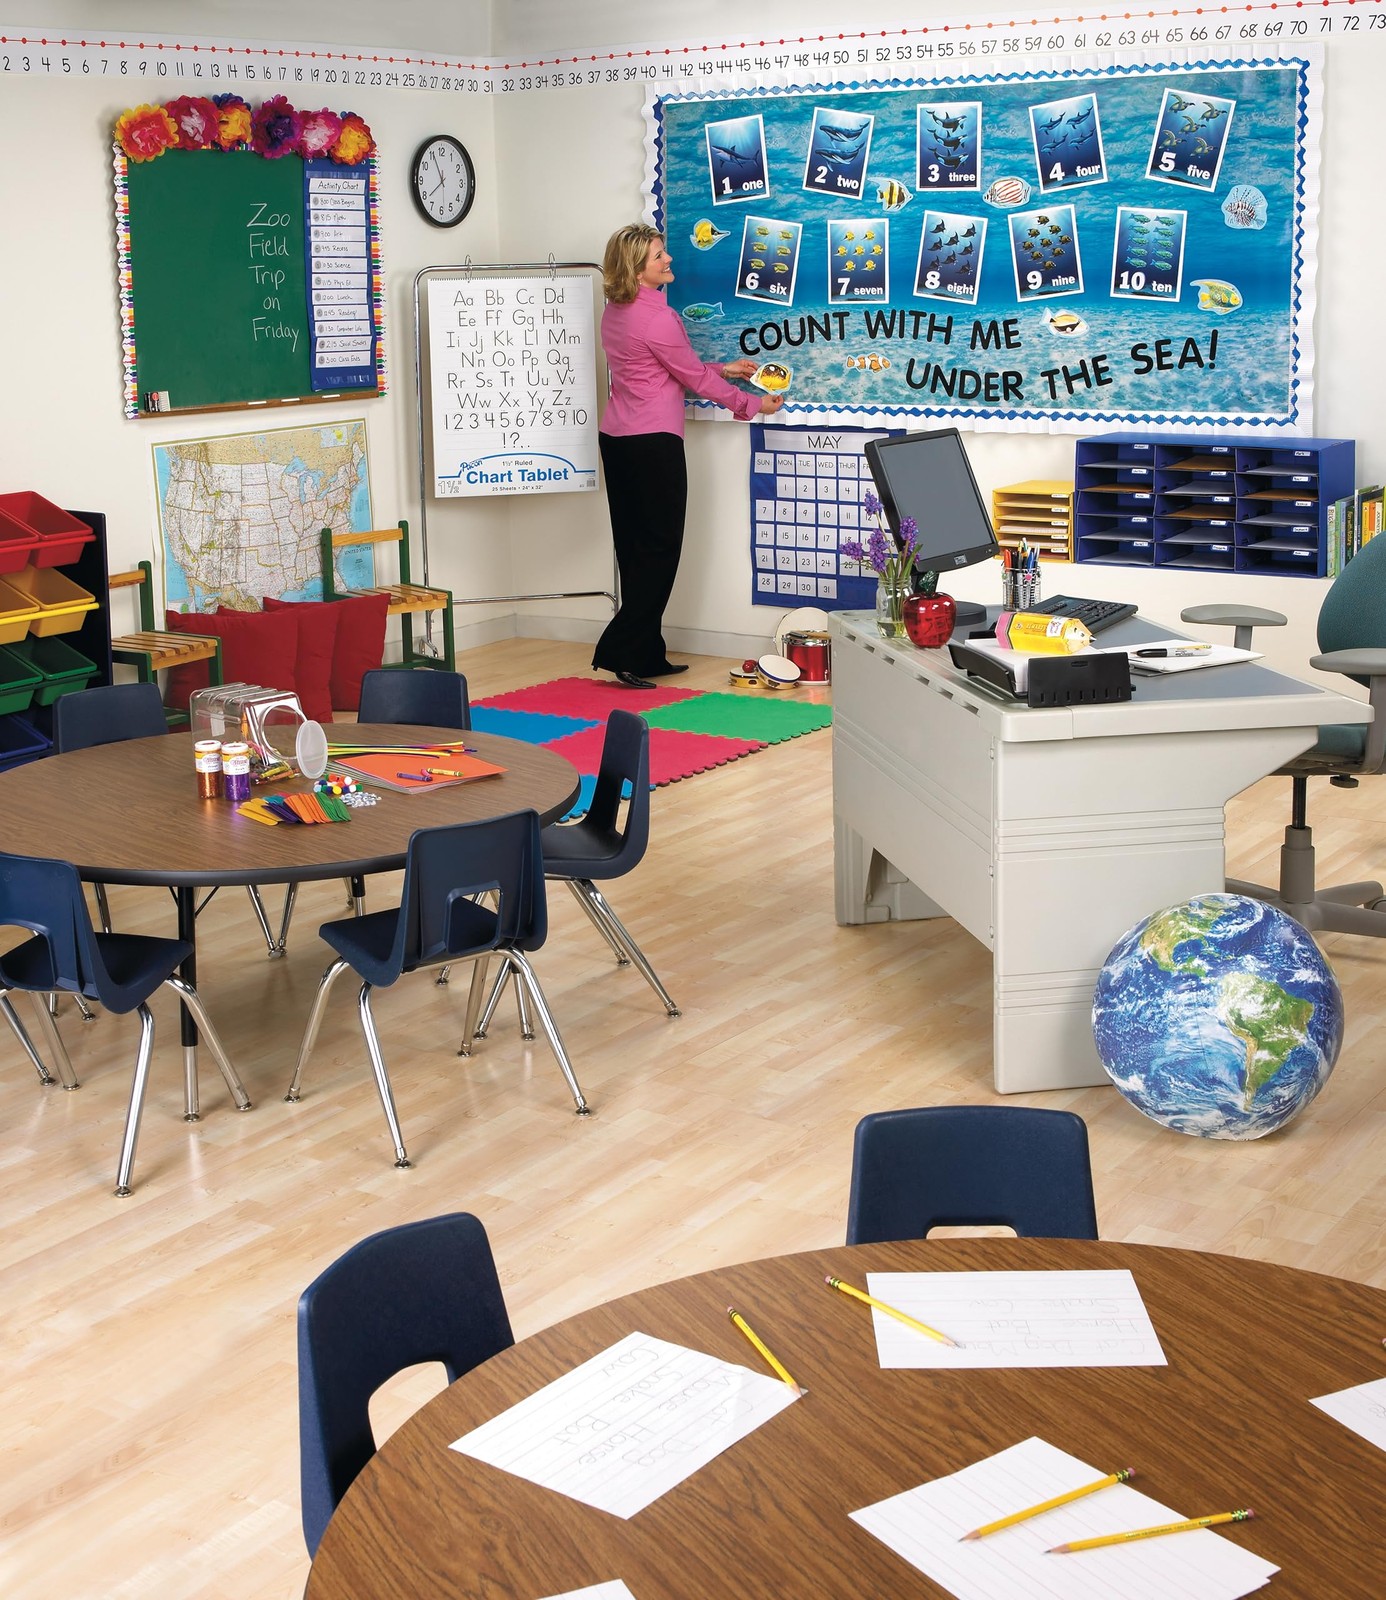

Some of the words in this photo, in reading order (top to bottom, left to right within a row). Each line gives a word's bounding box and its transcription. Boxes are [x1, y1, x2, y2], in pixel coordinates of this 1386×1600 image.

[1190, 26, 1208, 41] 66
[1215, 25, 1231, 39] 67
[1240, 24, 1258, 38] 68
[1264, 22, 1283, 37] 69
[1290, 21, 1307, 35] 70
[1320, 17, 1331, 32] 71
[1343, 16, 1359, 31] 72
[1369, 14, 1386, 29] 73
[3, 56, 11, 71] 2
[22, 56, 31, 71] 3
[41, 57, 51, 72] 4
[61, 58, 71, 73] 5
[82, 60, 90, 73] 6
[101, 60, 108, 74] 7
[120, 60, 128, 74] 8
[138, 61, 147, 75] 9
[641, 66, 656, 78] 40
[662, 65, 673, 78] 41
[680, 64, 693, 76] 42
[699, 62, 713, 75] 43
[716, 60, 732, 73] 44
[736, 59, 751, 72] 45
[755, 57, 771, 70] 46
[438, 147, 446, 157] 12
[449, 153, 453, 162] 1
[421, 161, 429, 171] 10
[455, 164, 461, 173] 2
[927, 164, 940, 182] 3
[949, 172, 976, 182] three
[1049, 162, 1065, 181] 4
[1076, 164, 1101, 178] four
[1159, 151, 1176, 172] 5
[1187, 165, 1210, 180] five
[318, 181, 341, 192] Activity
[342, 180, 359, 190] Chart
[418, 176, 424, 185] 9
[458, 179, 464, 188] 3
[722, 177, 733, 195] 1
[742, 179, 763, 191] one
[815, 166, 828, 184] 2
[836, 175, 859, 190] two
[422, 191, 428, 200] 8
[455, 193, 460, 202] 4
[246, 203, 291, 227] Zoo
[429, 201, 435, 211] 7
[439, 206, 444, 215] 6
[448, 203, 453, 212] 5
[249, 233, 290, 258] Field
[248, 265, 286, 290] Trip
[745, 272, 759, 290] 6
[769, 282, 787, 296] six
[837, 277, 851, 295] 7
[854, 286, 884, 296] seven
[925, 271, 941, 289] 8
[947, 283, 974, 296] eight
[1026, 270, 1043, 290] 9
[1052, 275, 1076, 287] nine
[1119, 271, 1145, 290] 10
[1152, 280, 1173, 293] ten
[263, 296, 281, 311] on
[453, 290, 474, 306] Aa
[485, 289, 504, 306] Bb
[516, 289, 535, 305] Cc
[544, 288, 565, 304] Dd
[458, 311, 476, 327] Ee
[485, 310, 502, 326] Ff
[512, 309, 535, 332] Gg
[542, 308, 564, 325] Hh
[252, 316, 300, 352] Friday
[469, 331, 484, 354] Jj
[493, 330, 514, 346] Kk
[548, 328, 581, 344] Mm
[740, 311, 850, 356] COUNT
[864, 309, 953, 345] WITH
[970, 318, 1022, 351] ME
[461, 351, 485, 368] Nn
[492, 351, 515, 367] Oo
[522, 349, 539, 372] Pp
[546, 348, 574, 372] Qq
[906, 358, 1024, 401] UNDER
[1041, 354, 1113, 400] THE
[1130, 329, 1218, 375] SEA!
[448, 372, 466, 388] Rr
[475, 372, 493, 388] Ss
[500, 371, 515, 387] Tt
[527, 370, 549, 387] Uu
[556, 369, 576, 385] Vv
[457, 392, 491, 409] Ww
[499, 391, 521, 408] Xx
[527, 390, 545, 413] Yy
[552, 389, 572, 406] Zz
[807, 435, 842, 449] MAY
[798, 460, 811, 468] TUE
[817, 461, 834, 469] WED
[839, 462, 856, 470] THUR
[466, 470, 513, 484] Chart
[518, 467, 569, 482] Tablet
[844, 487, 850, 495] 4
[761, 577, 770, 586] 28
[801, 583, 811, 591] 30
[601, 1348, 659, 1377] Cow
